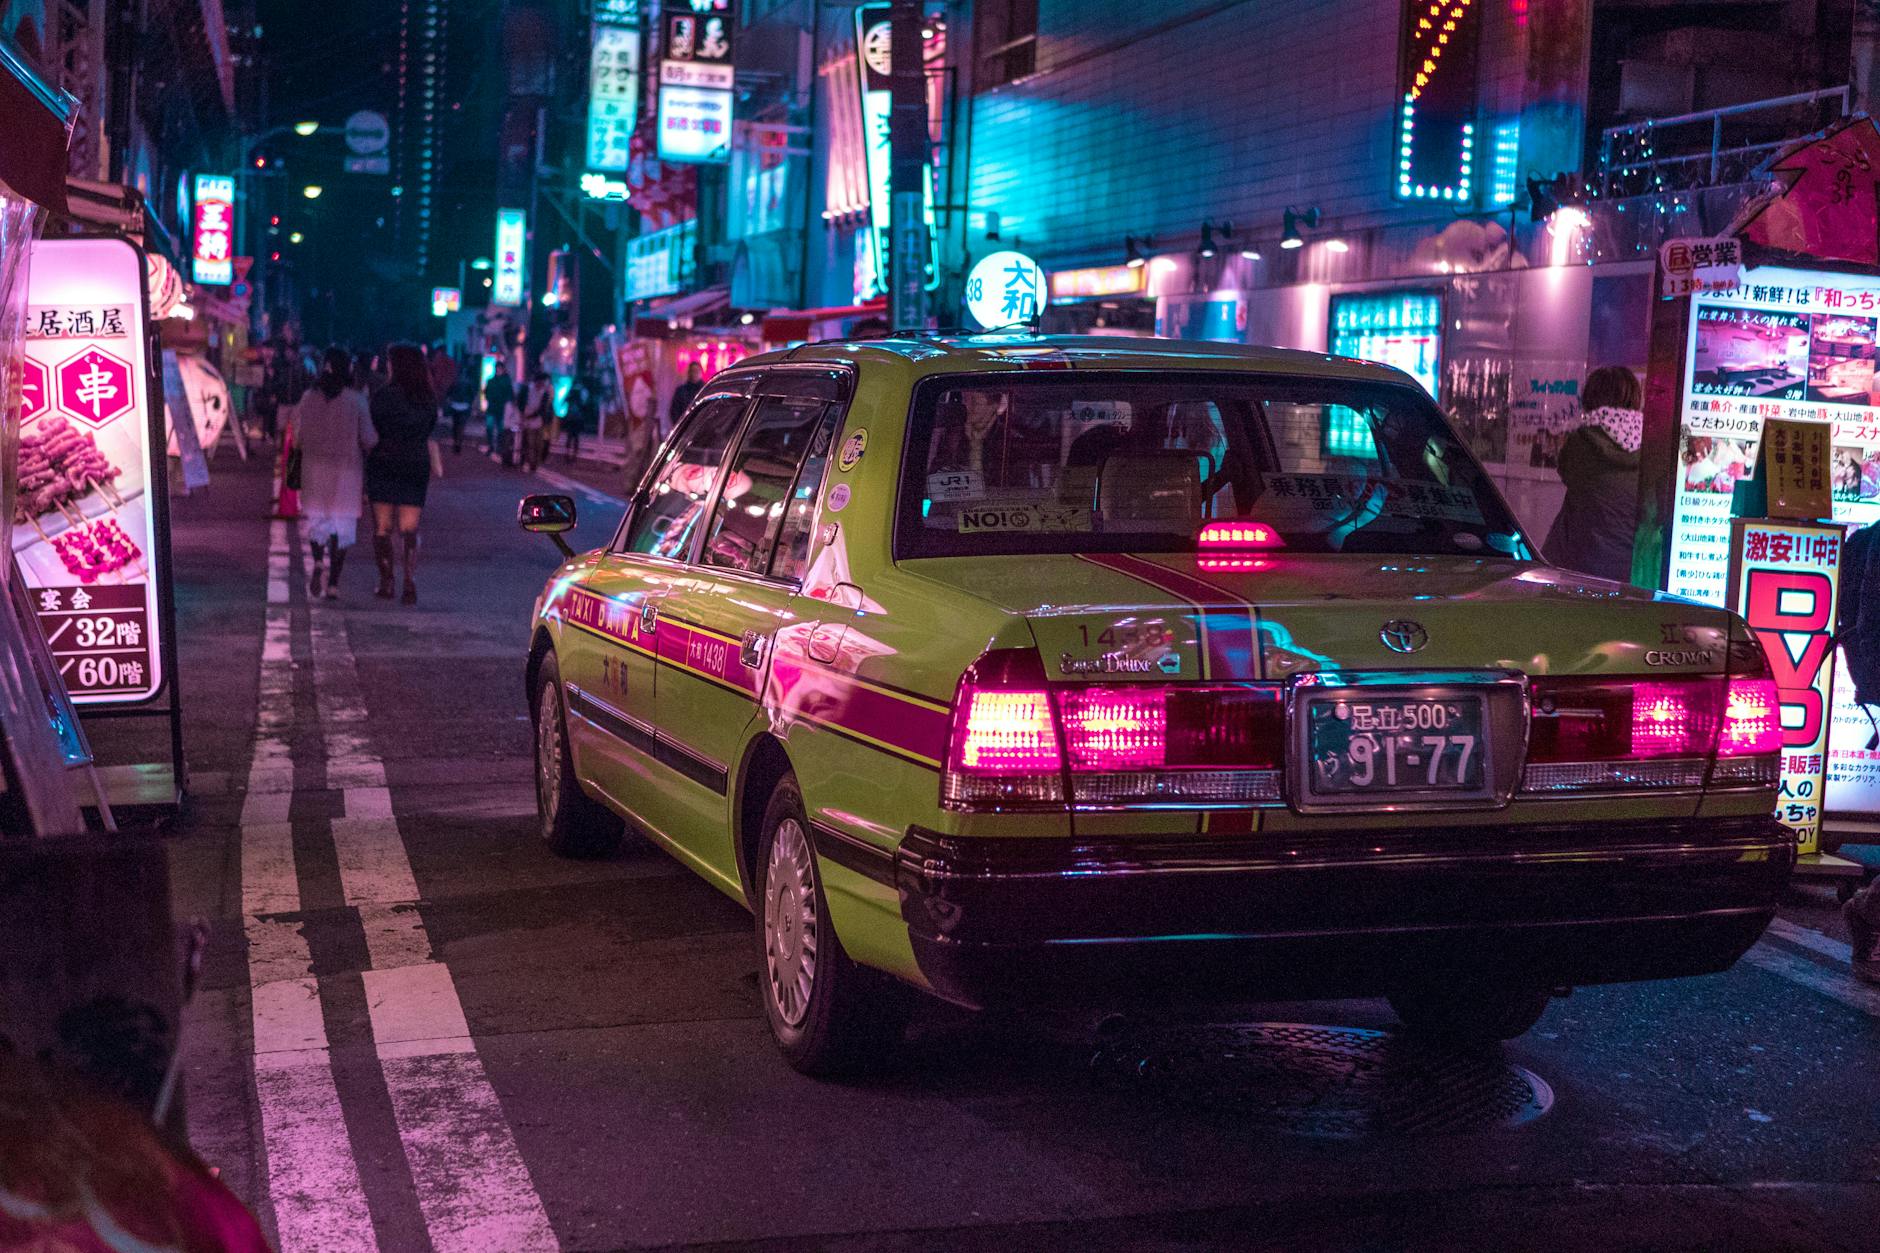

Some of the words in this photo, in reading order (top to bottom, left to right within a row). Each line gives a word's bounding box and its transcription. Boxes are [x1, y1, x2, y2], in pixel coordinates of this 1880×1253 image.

[1001, 260, 1035, 320] 大和
[75, 362, 118, 418] 串
[40, 587, 93, 611] 宴会
[1102, 652, 1152, 674] Deluxe
[1645, 650, 1713, 666] CROWN
[1745, 569, 1832, 748] DVD
[1402, 704, 1446, 730] 500
[1349, 734, 1475, 787] 91-77
[1776, 804, 1817, 823] ちゃ
